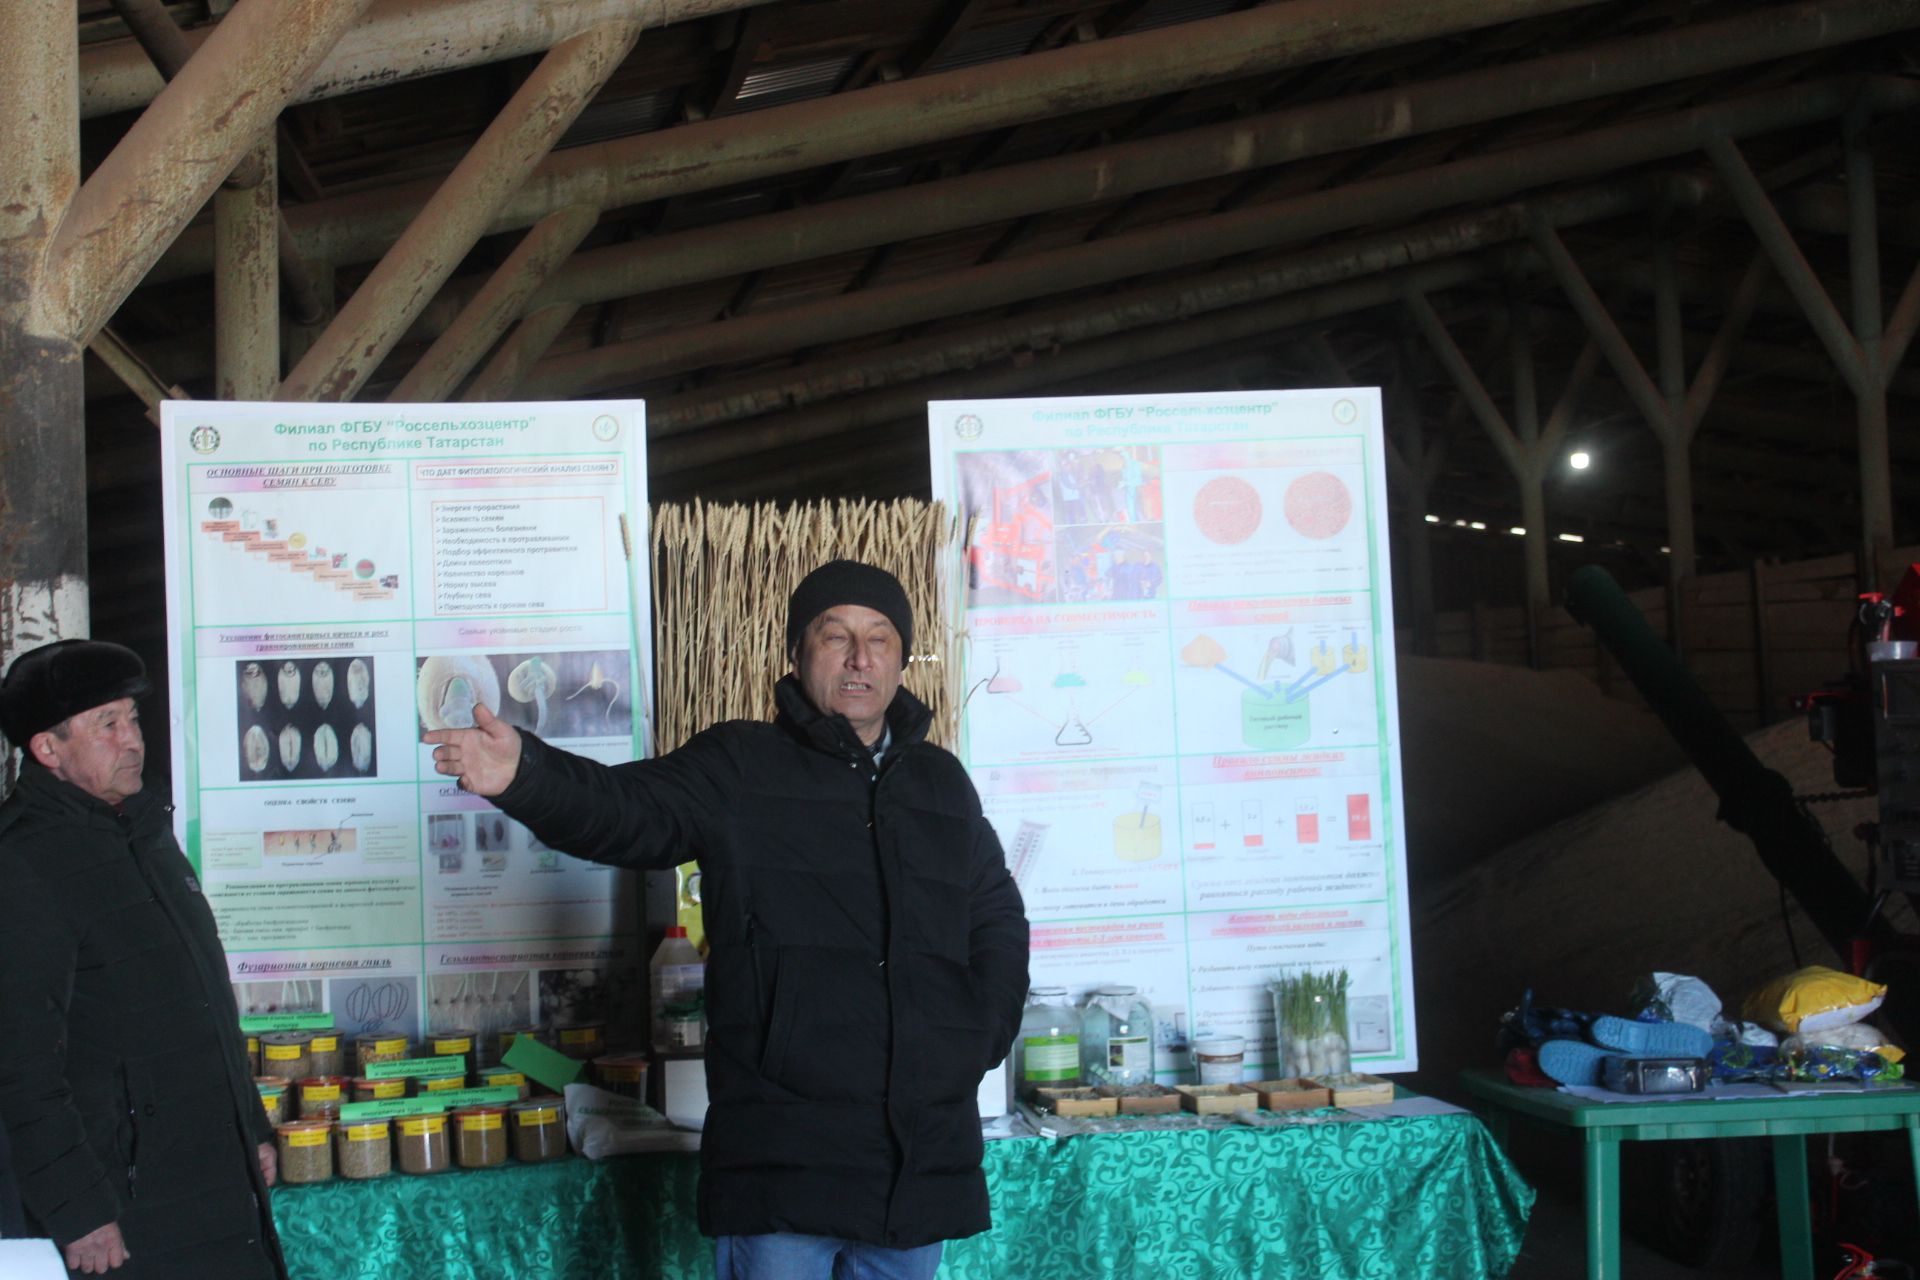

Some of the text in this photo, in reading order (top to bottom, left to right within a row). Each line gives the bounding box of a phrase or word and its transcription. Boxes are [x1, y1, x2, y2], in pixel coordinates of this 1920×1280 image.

[1032, 409, 1090, 421] Филиал
[1093, 407, 1134, 420] ФГБУ
[274, 422, 335, 435] Филиал
[341, 420, 383, 434] ФГБУ
[1065, 421, 1249, 439] по Республике Татарстан
[308, 435, 505, 454] по Республике Татарстан
[206, 463, 392, 478] ОСНОВНЫЕ ШАГИ ПРИ ПОДГОТОВКЕ
[419, 468, 435, 477] ЧТО
[262, 477, 300, 488] СЕМЯН
[310, 476, 338, 487] СЕВУ
[975, 610, 1157, 627] ПРОВЕРКА НА СОВМЕСТИМОСТЬ
[237, 956, 392, 974] Фузариозная корневая гниль
